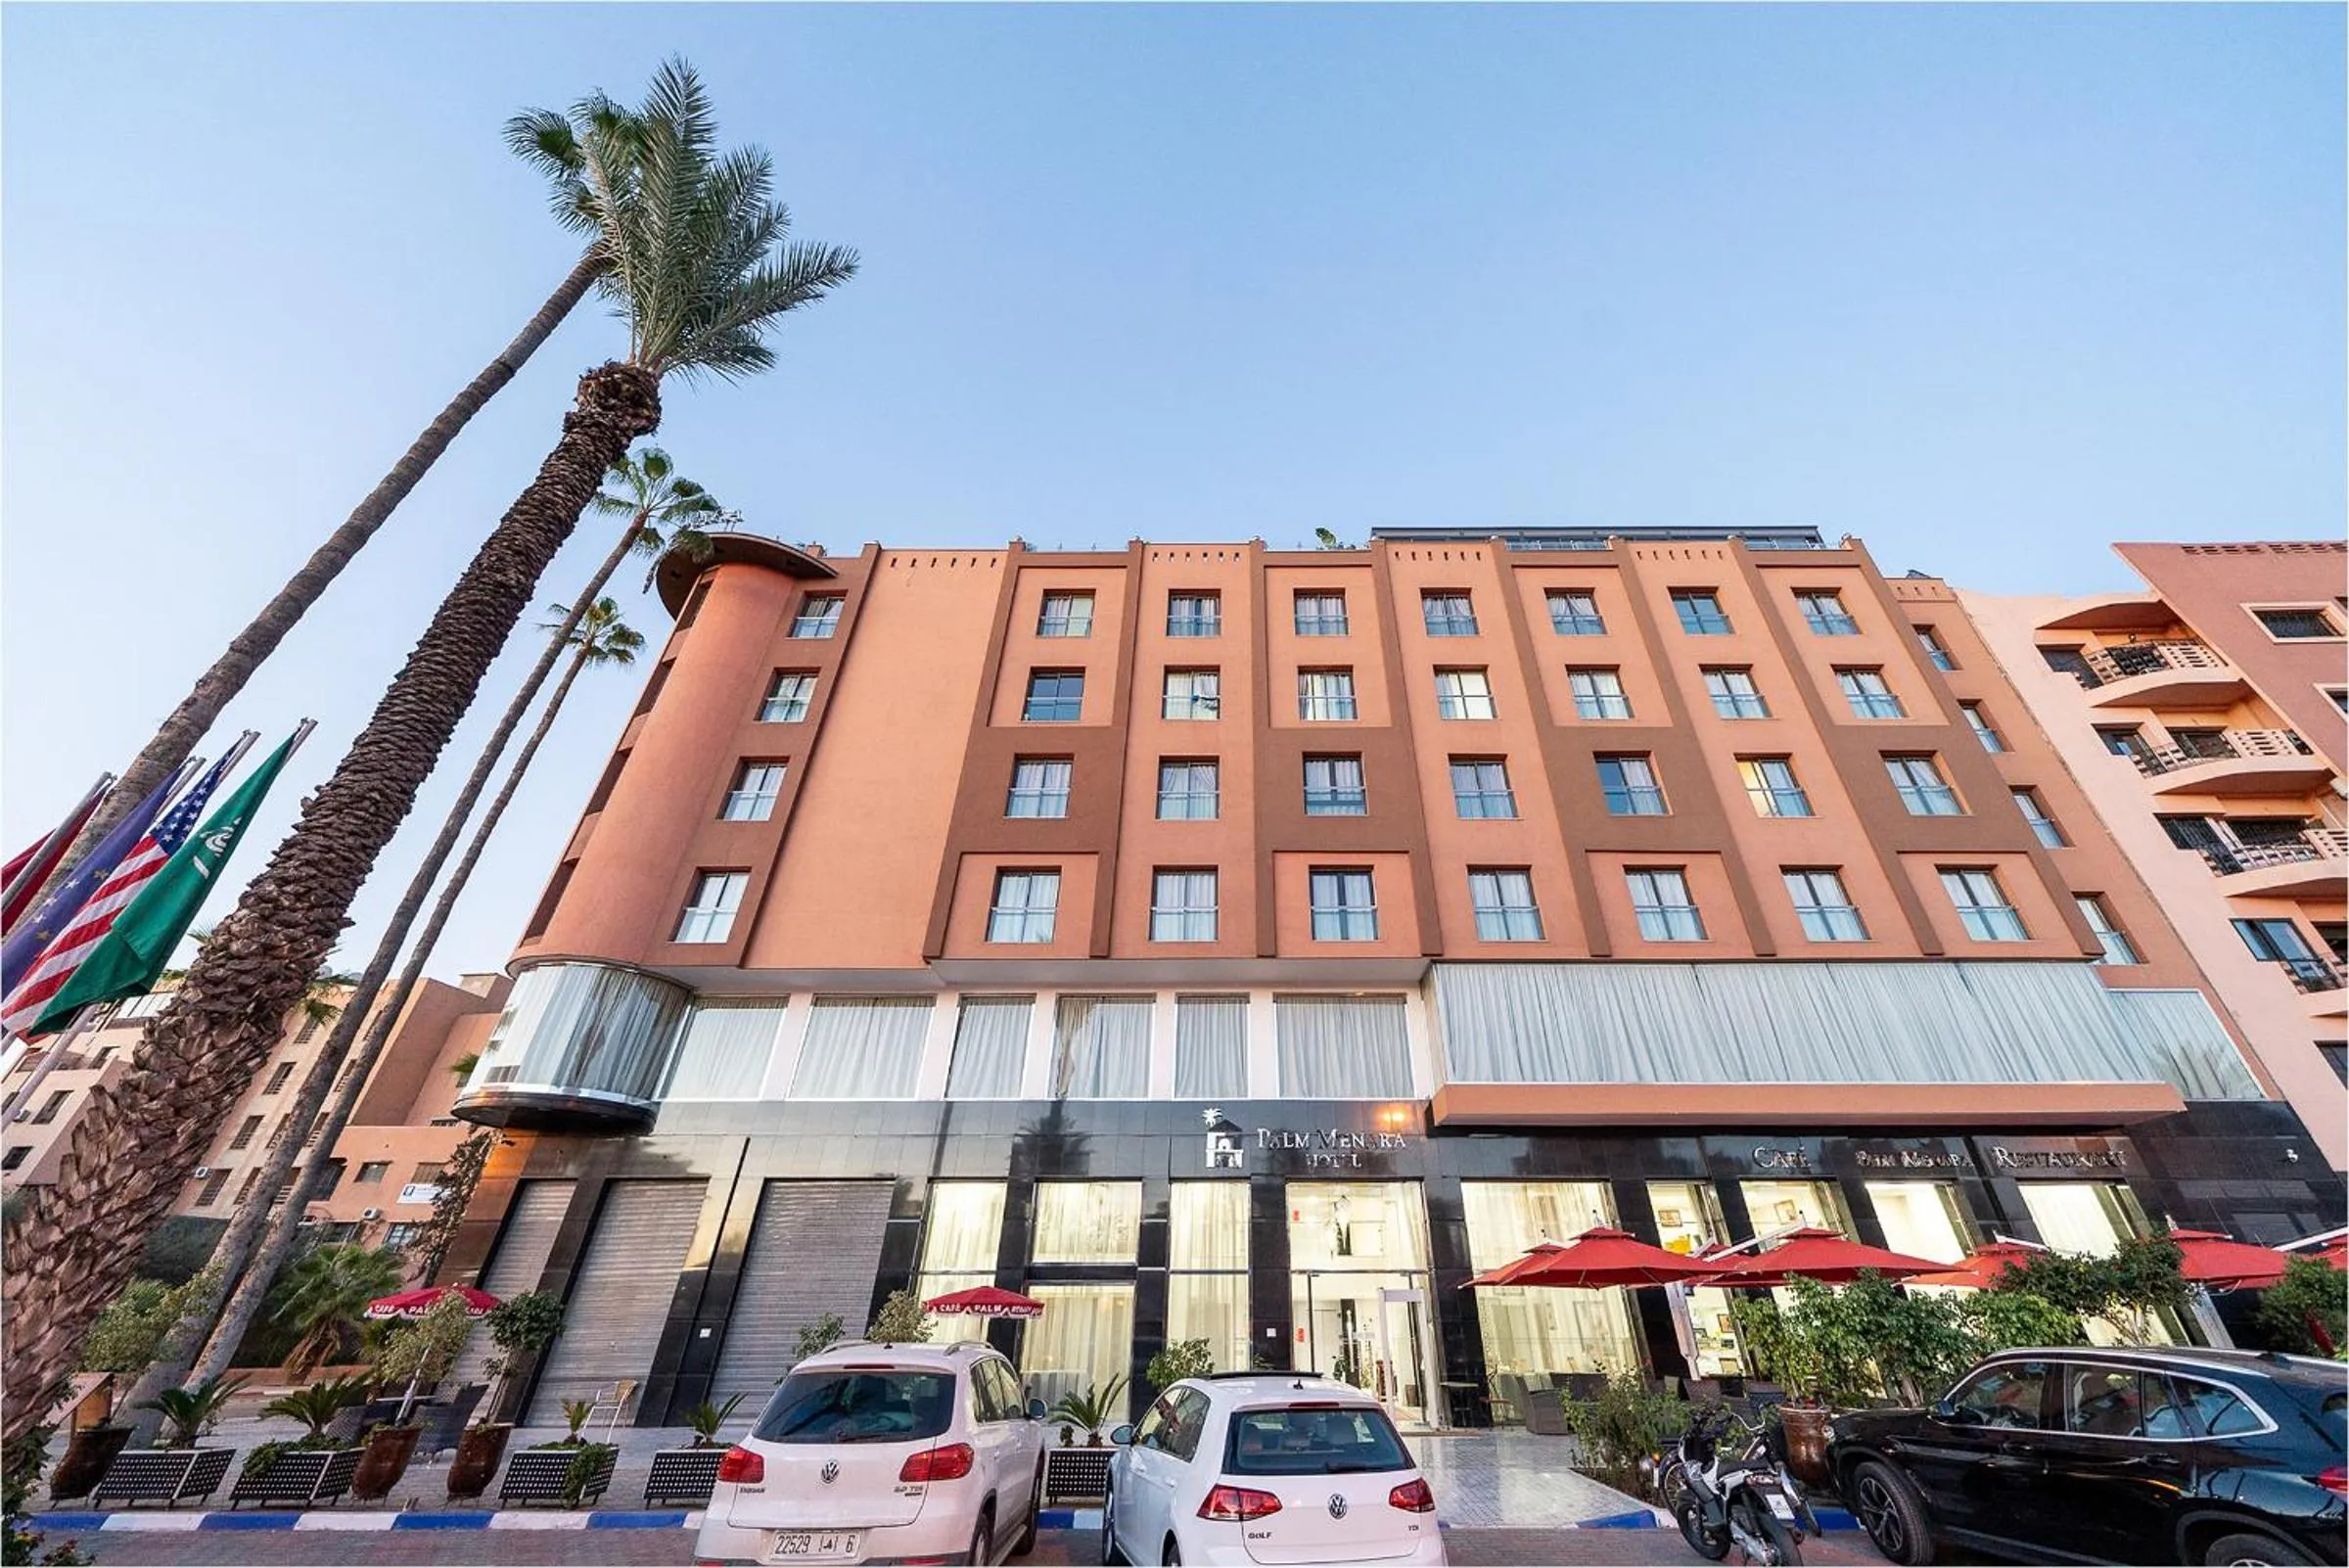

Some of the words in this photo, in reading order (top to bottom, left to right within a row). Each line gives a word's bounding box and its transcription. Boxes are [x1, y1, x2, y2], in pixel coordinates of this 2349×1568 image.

[1257, 1128, 1311, 1149] PALM
[1316, 1128, 1406, 1149] MENRA
[1305, 1153, 1362, 1169] HOTL
[974, 1304, 1002, 1313] PALM
[774, 1535, 811, 1555] 22529
[845, 1534, 856, 1553] 6
